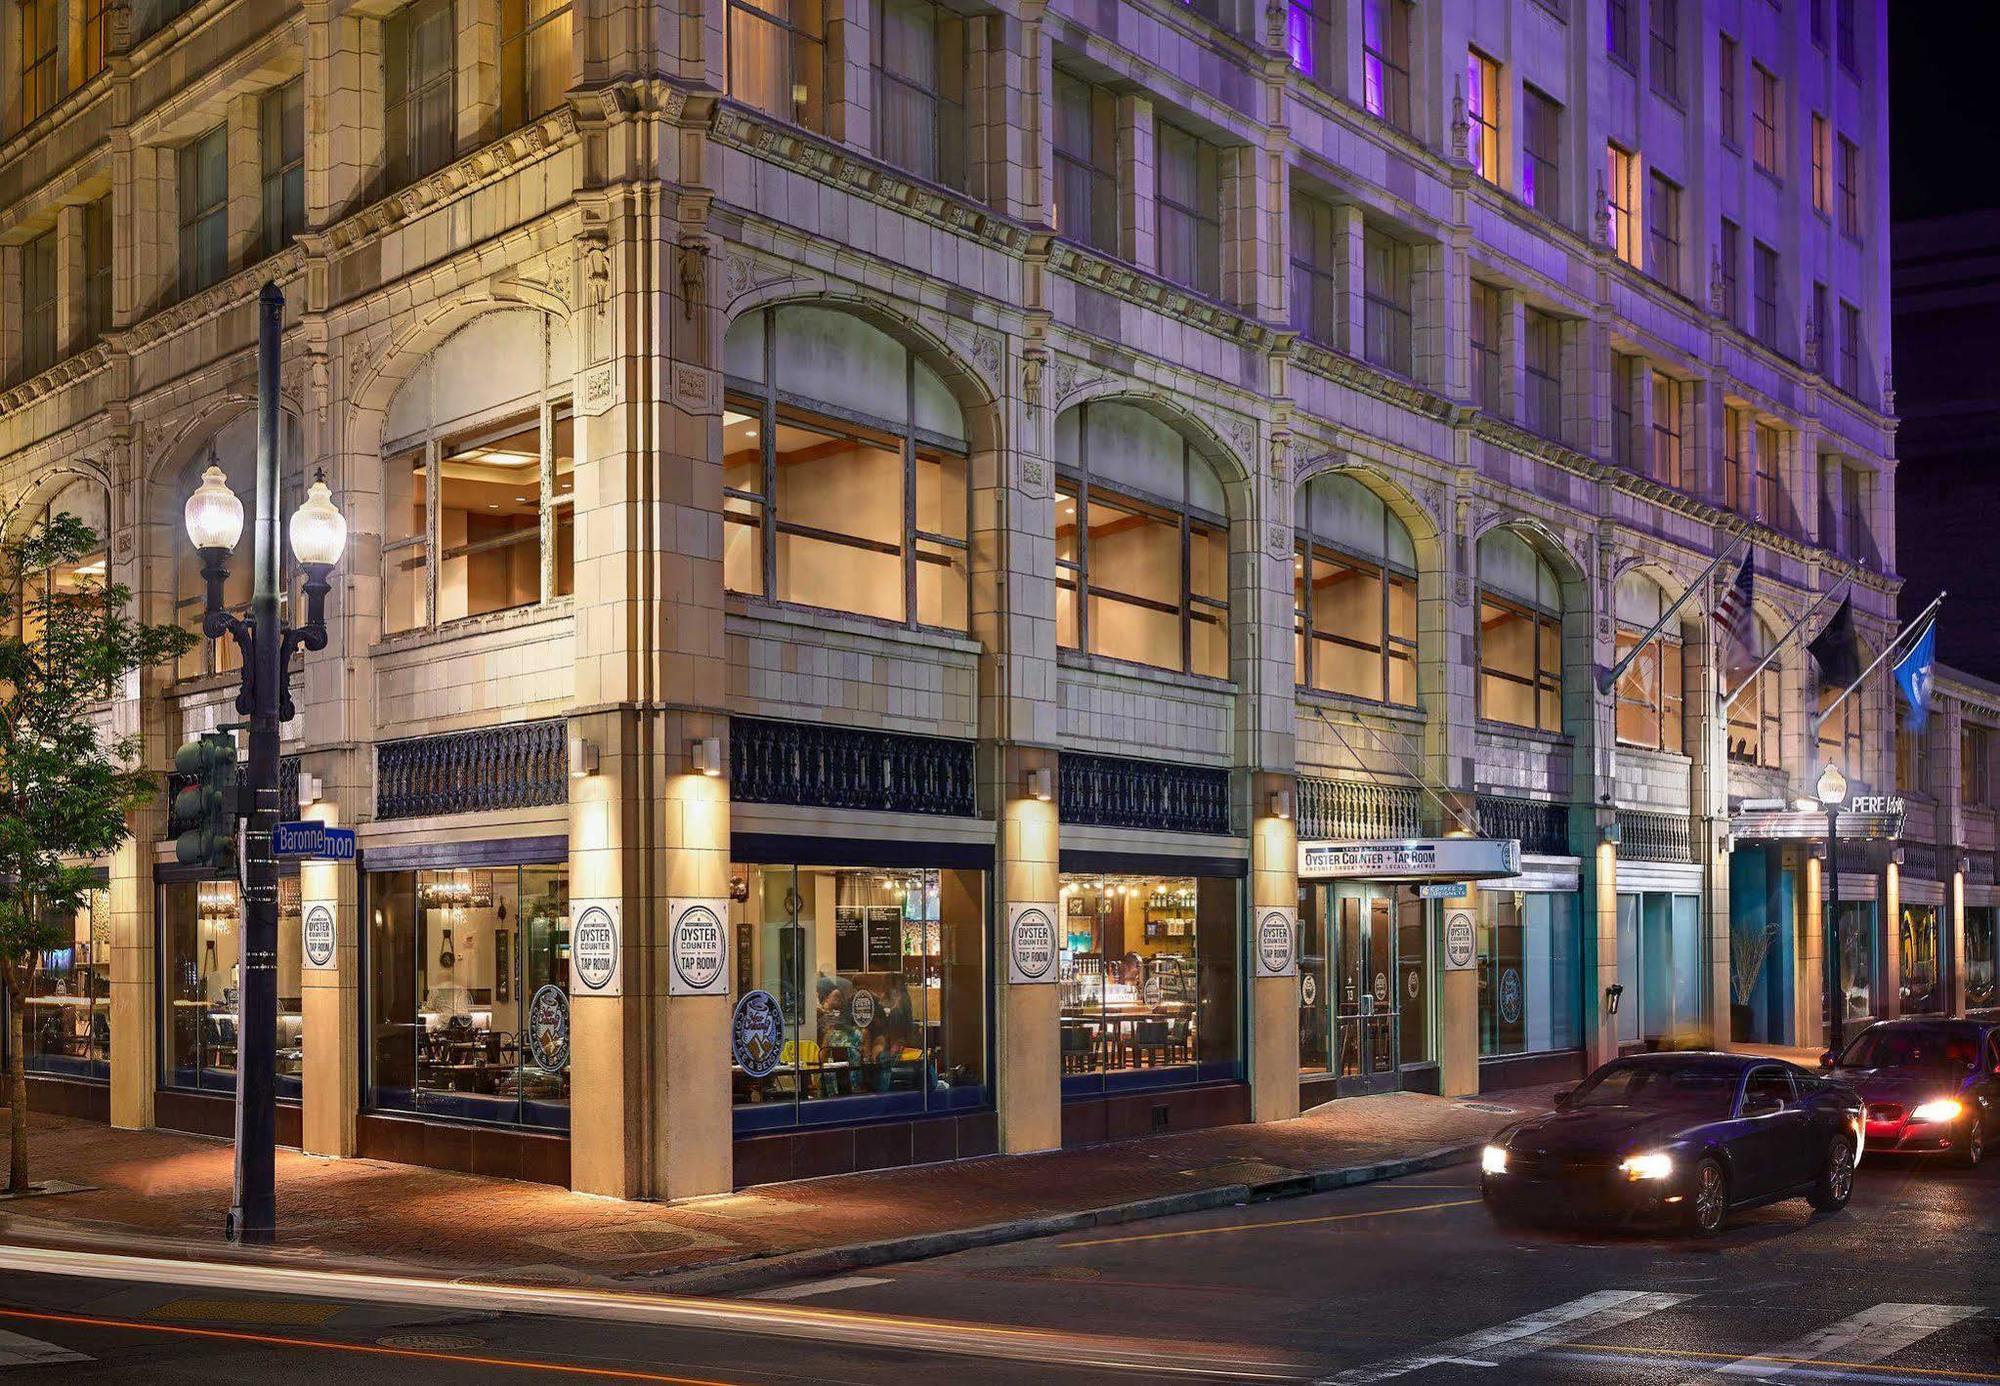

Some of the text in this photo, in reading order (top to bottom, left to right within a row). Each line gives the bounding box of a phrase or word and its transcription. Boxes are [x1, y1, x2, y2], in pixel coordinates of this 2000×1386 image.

[1852, 796, 1885, 813] PERE
[280, 826, 323, 850] Baronne
[1305, 853, 1341, 866] OYSTER
[1342, 852, 1384, 865] COUNTER
[1393, 851, 1410, 863] TAP
[1411, 851, 1435, 863] ROOM
[580, 929, 610, 942] OYSTER
[681, 928, 717, 941] OYSTER
[1018, 927, 1048, 939] OYSTER
[1263, 928, 1288, 938] OYSTER
[1018, 951, 1048, 962] TAP ROOM
[580, 958, 610, 970] TAP ROOM
[681, 957, 717, 970] TAP ROOM
